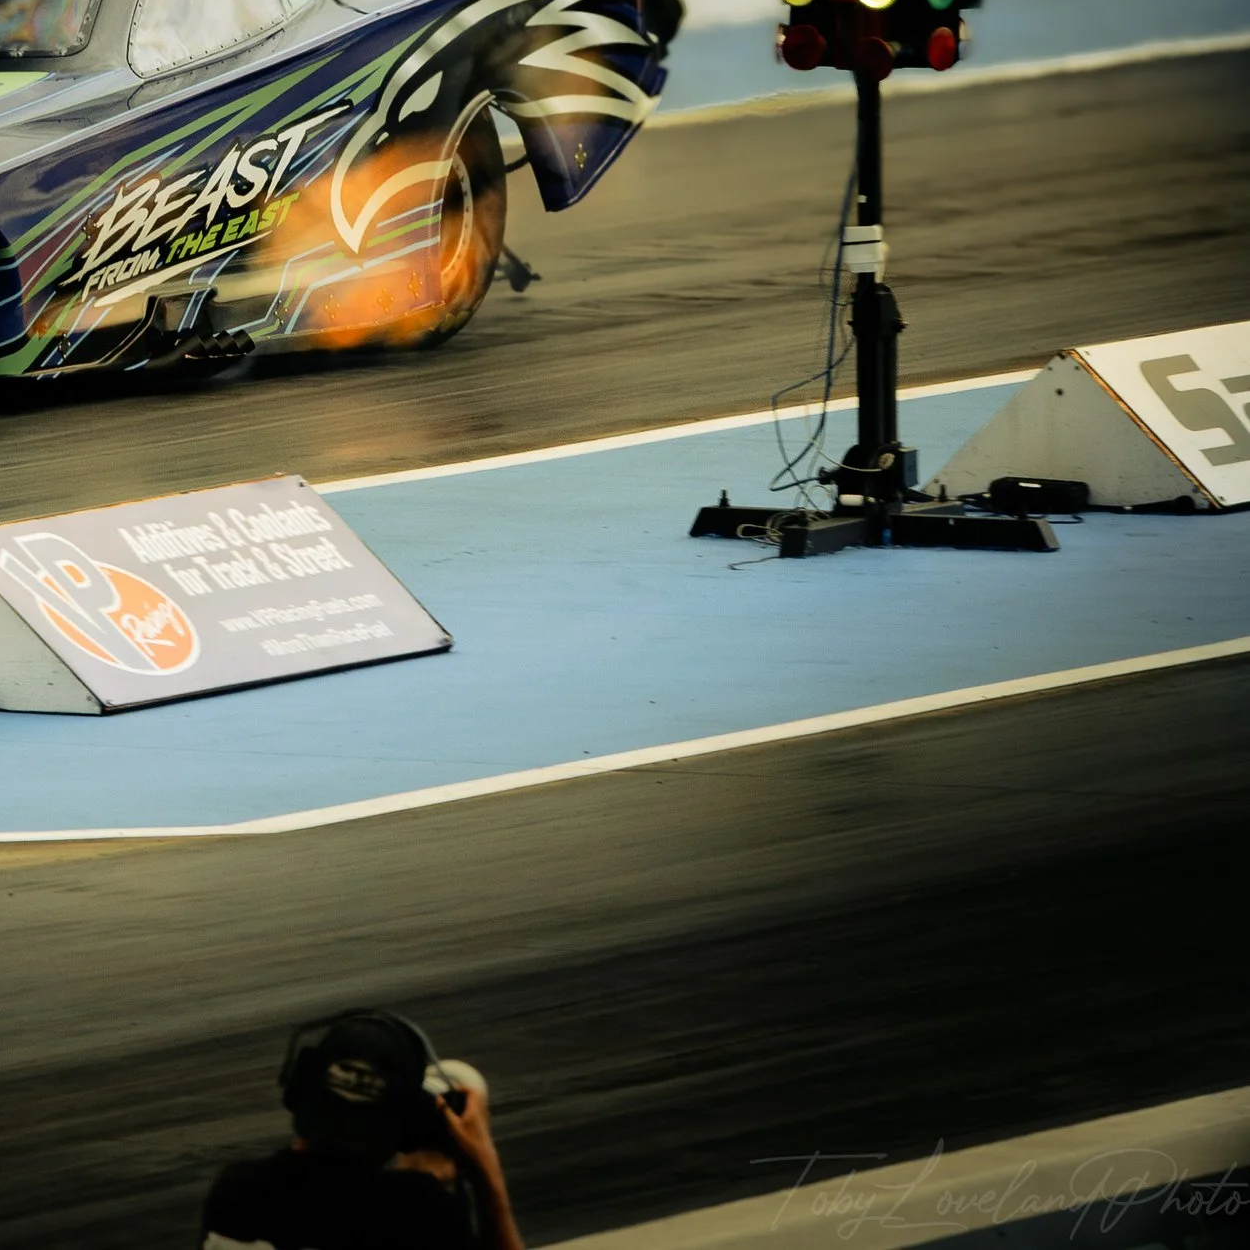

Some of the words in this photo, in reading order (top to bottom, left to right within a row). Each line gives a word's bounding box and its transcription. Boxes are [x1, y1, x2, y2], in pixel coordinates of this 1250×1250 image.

[59, 105, 350, 286] BEAST
[82, 247, 160, 302] FROM
[166, 223, 223, 264] THE
[224, 194, 299, 242] EAST
[121, 522, 227, 563] Additives
[227, 500, 333, 544] Coolants
[192, 551, 271, 590] Track
[274, 537, 354, 577] Street
